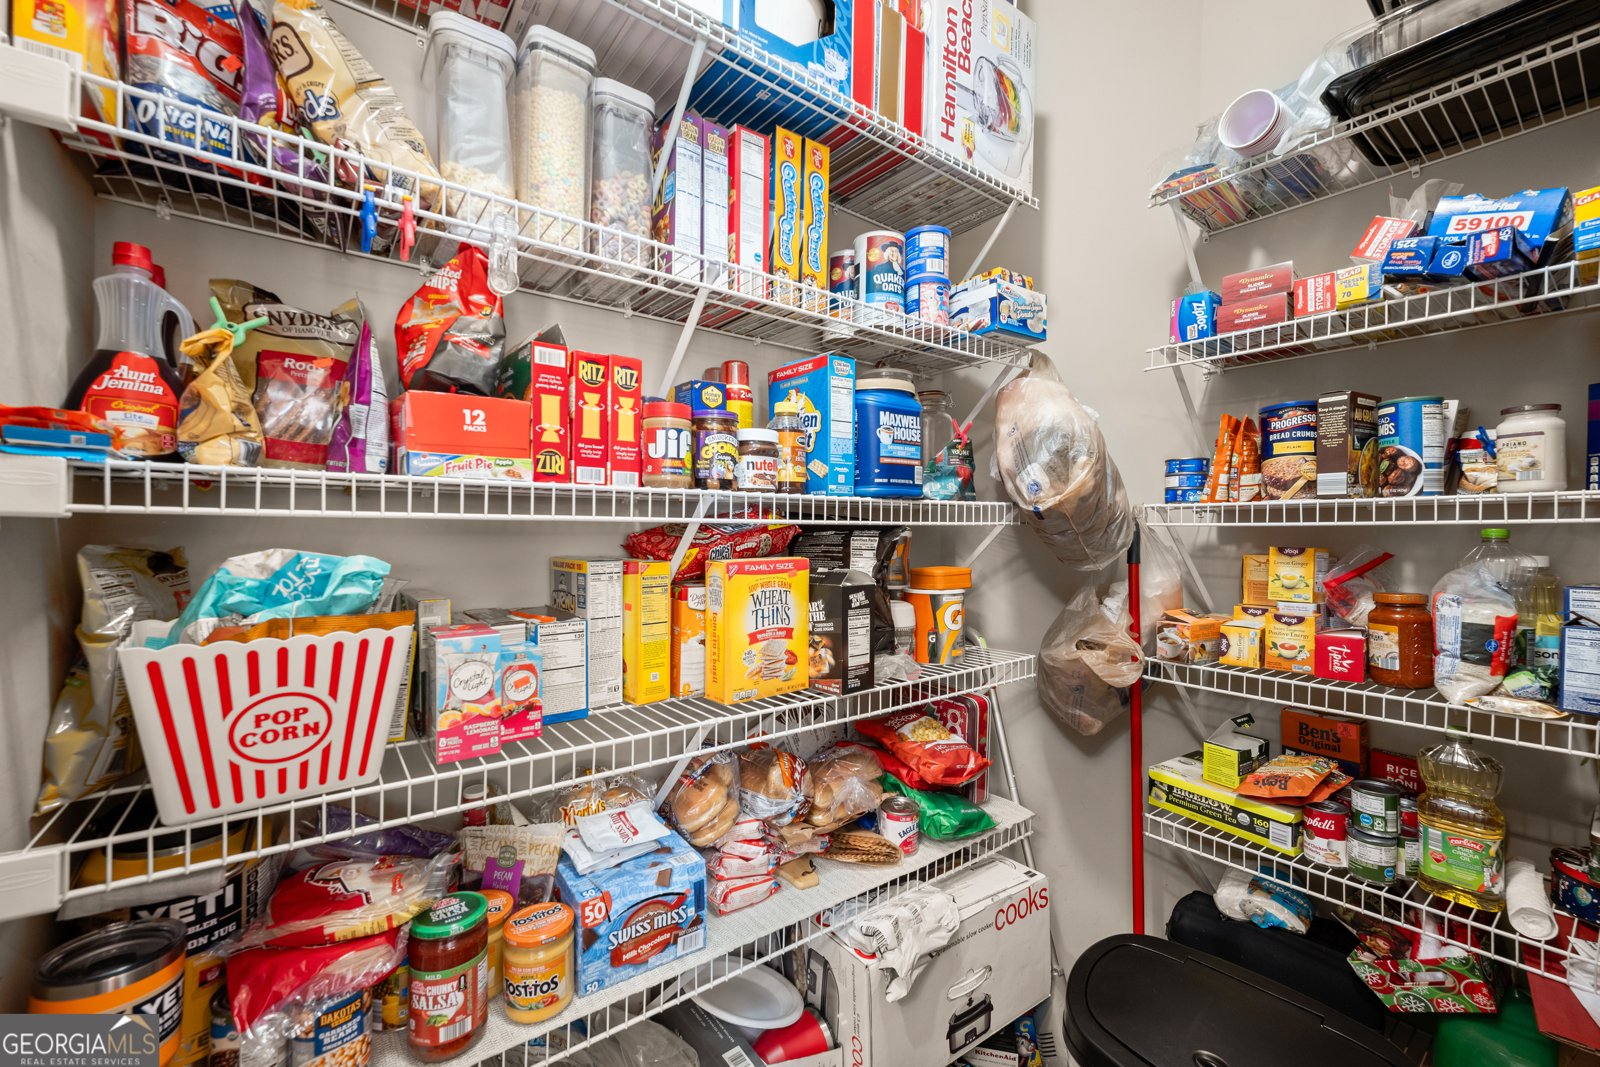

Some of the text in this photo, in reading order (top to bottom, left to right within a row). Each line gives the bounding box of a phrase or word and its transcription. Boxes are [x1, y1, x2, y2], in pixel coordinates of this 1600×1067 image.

[940, 6, 958, 143] Hamilton
[779, 161, 798, 265] Golden Crisp
[808, 172, 826, 273] Golden Crisp
[1453, 213, 1526, 232] 59100
[1239, 273, 1274, 285] Dynamics
[1337, 267, 1362, 280] GLAD
[426, 275, 459, 293] CHIPS
[1315, 276, 1324, 311] STORAGE
[1341, 290, 1352, 298] 70
[1191, 300, 1208, 331] Ziploc
[1233, 303, 1269, 315] Dynamics
[113, 364, 156, 384] Aunt
[578, 359, 606, 383] RITZ
[613, 365, 639, 388] RITZ
[776, 361, 814, 379] FAMILY SIZE
[92, 375, 165, 396] Jemima
[111, 400, 160, 414] Original
[123, 412, 144, 420] Lite
[462, 408, 487, 426] 12
[879, 409, 921, 429] MAXWELL
[1271, 413, 1317, 431] PROGRESSO
[463, 424, 487, 433] PACKS
[893, 429, 921, 442] HOUSE
[1269, 429, 1318, 442] BREAD CRUMBS
[647, 428, 692, 460] Jif
[1501, 440, 1527, 448] PRIANO
[444, 456, 493, 474] Fruit Pie
[494, 458, 514, 466] Apple
[535, 454, 566, 476] RITZ
[745, 458, 779, 472] nutell
[1283, 547, 1299, 556] yogi
[744, 562, 795, 572] FAMILY SIZE
[1290, 560, 1310, 568] Ginger
[709, 588, 723, 599] WHEAT
[760, 581, 792, 590] WHOLE GRAIN
[750, 589, 791, 608] WHEAT
[1246, 606, 1263, 616] yogi
[1279, 615, 1299, 625] yogi
[573, 632, 585, 640] 130
[1267, 629, 1310, 641] Positive Energy
[253, 706, 310, 730] POP
[463, 719, 499, 731] RASPBERRY
[238, 720, 321, 749] CORN
[465, 725, 499, 737] LEMONADE
[1298, 721, 1342, 744] Ben's
[1298, 735, 1342, 753] Original
[1386, 763, 1418, 778] RICE
[1167, 794, 1238, 825] Premium Green Tea
[1252, 816, 1270, 829] 160
[1451, 848, 1480, 860] CANOLA
[1459, 855, 1472, 863] OIL
[493, 870, 513, 882] PECAN
[582, 889, 596, 899] 50
[135, 883, 235, 924] YETI
[428, 900, 467, 916] CHUNKY
[583, 902, 607, 921] 50
[994, 886, 1049, 932] cooks
[431, 906, 470, 923] SALSA
[510, 904, 563, 928] TOSTITOS
[210, 921, 237, 941] JUG
[607, 903, 689, 951] SWISS MISS
[965, 921, 994, 941] slow cooker
[622, 931, 672, 962] Milk Chocolate
[426, 980, 458, 995] CHUNKY
[504, 974, 560, 999] TOSTITOS
[585, 981, 599, 994] 50
[411, 989, 460, 1012] SALSA
[322, 1023, 359, 1046] BEANS
[974, 1048, 1017, 1063] KitchenAid
